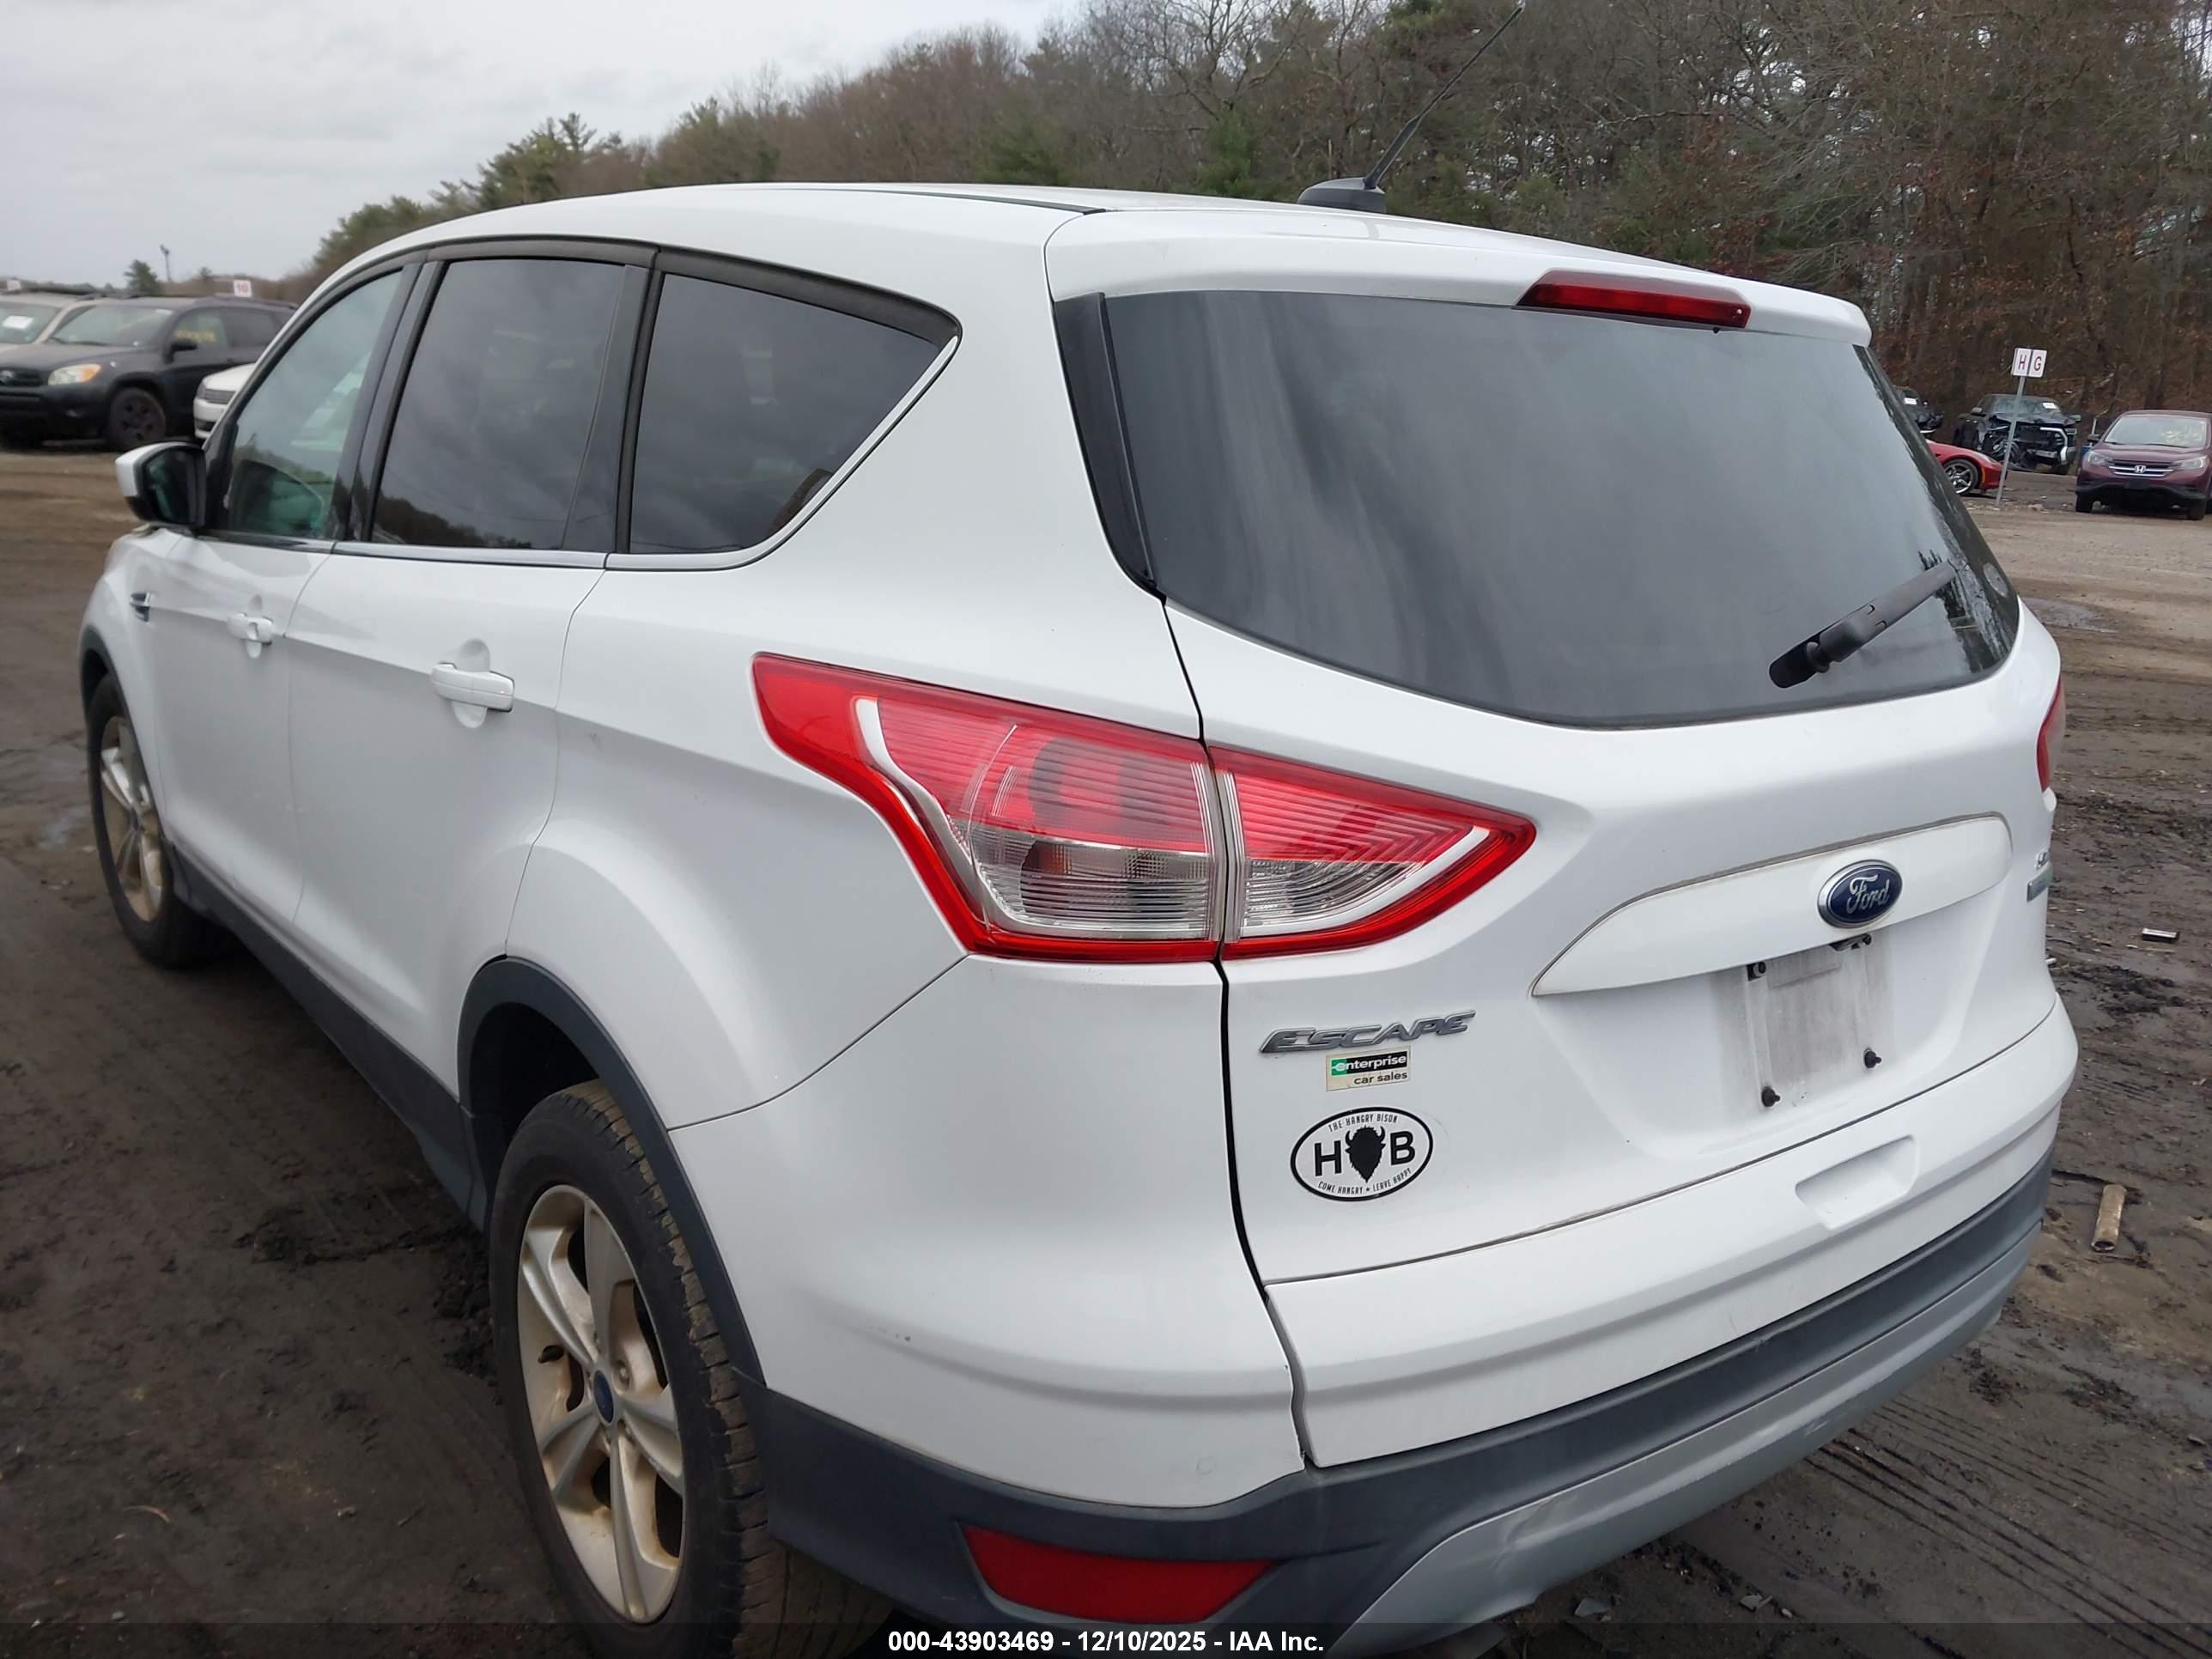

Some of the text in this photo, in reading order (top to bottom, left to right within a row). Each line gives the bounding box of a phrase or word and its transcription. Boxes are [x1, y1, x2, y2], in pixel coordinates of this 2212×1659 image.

[2018, 355, 2042, 371] H G
[1846, 874, 1890, 914] Ford
[1259, 1009, 1476, 1053] ESCAPE
[1333, 1054, 1407, 1073] enterprise
[1353, 1070, 1408, 1085] car sales
[1328, 1113, 1398, 1132] THE HANGRY BISON
[1314, 1131, 1416, 1176] H B
[1318, 1181, 1336, 1192] COME
[1372, 1180, 1391, 1192] LEAVE
[1394, 1167, 1413, 1184] HAPPY
